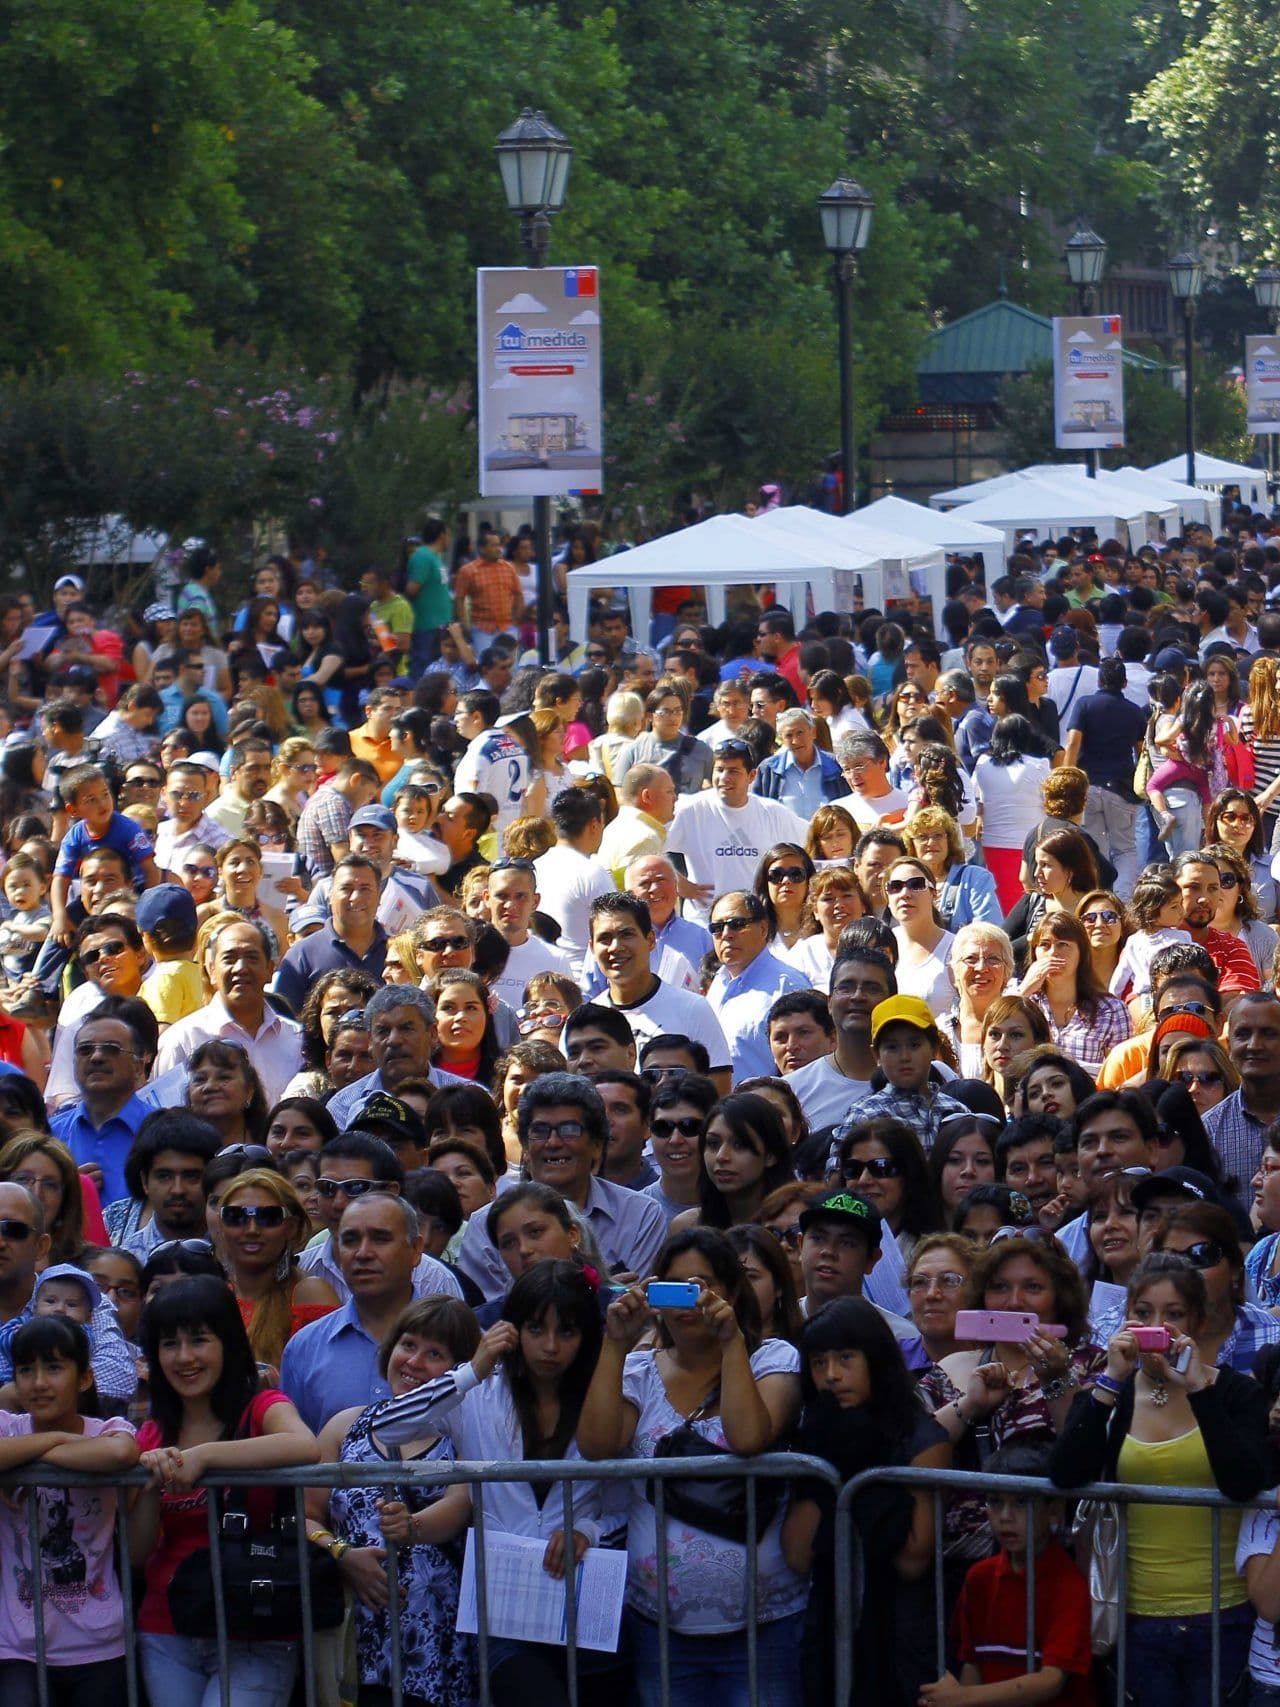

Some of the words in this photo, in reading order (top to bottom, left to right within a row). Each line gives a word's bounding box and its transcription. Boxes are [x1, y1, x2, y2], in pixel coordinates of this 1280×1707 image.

[527, 332, 586, 346] medida
[508, 760, 521, 802] 2
[715, 846, 758, 856] adidas
